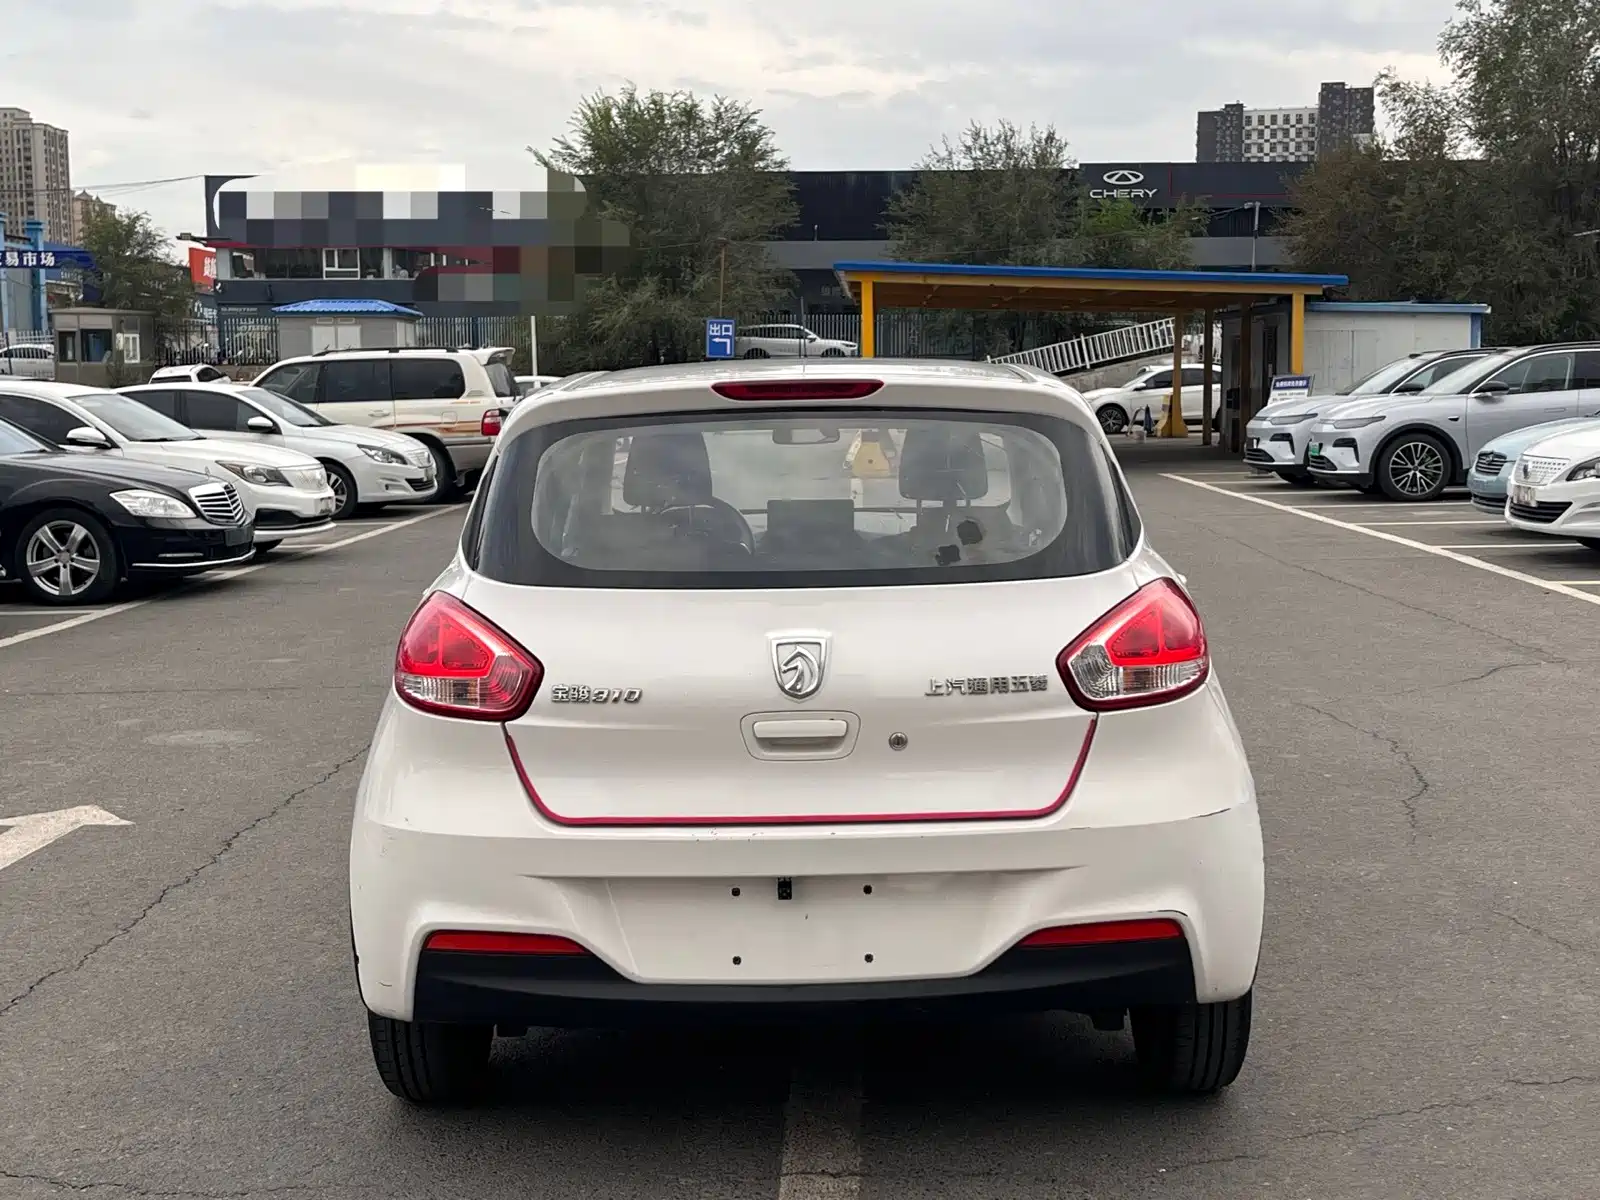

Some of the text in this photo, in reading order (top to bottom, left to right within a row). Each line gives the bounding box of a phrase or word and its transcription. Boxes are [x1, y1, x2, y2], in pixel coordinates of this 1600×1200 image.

[1089, 188, 1158, 199] CHERY
[0, 251, 55, 267] 易市场
[709, 323, 733, 336] 出口
[924, 673, 1048, 697] 上汽通用五菱
